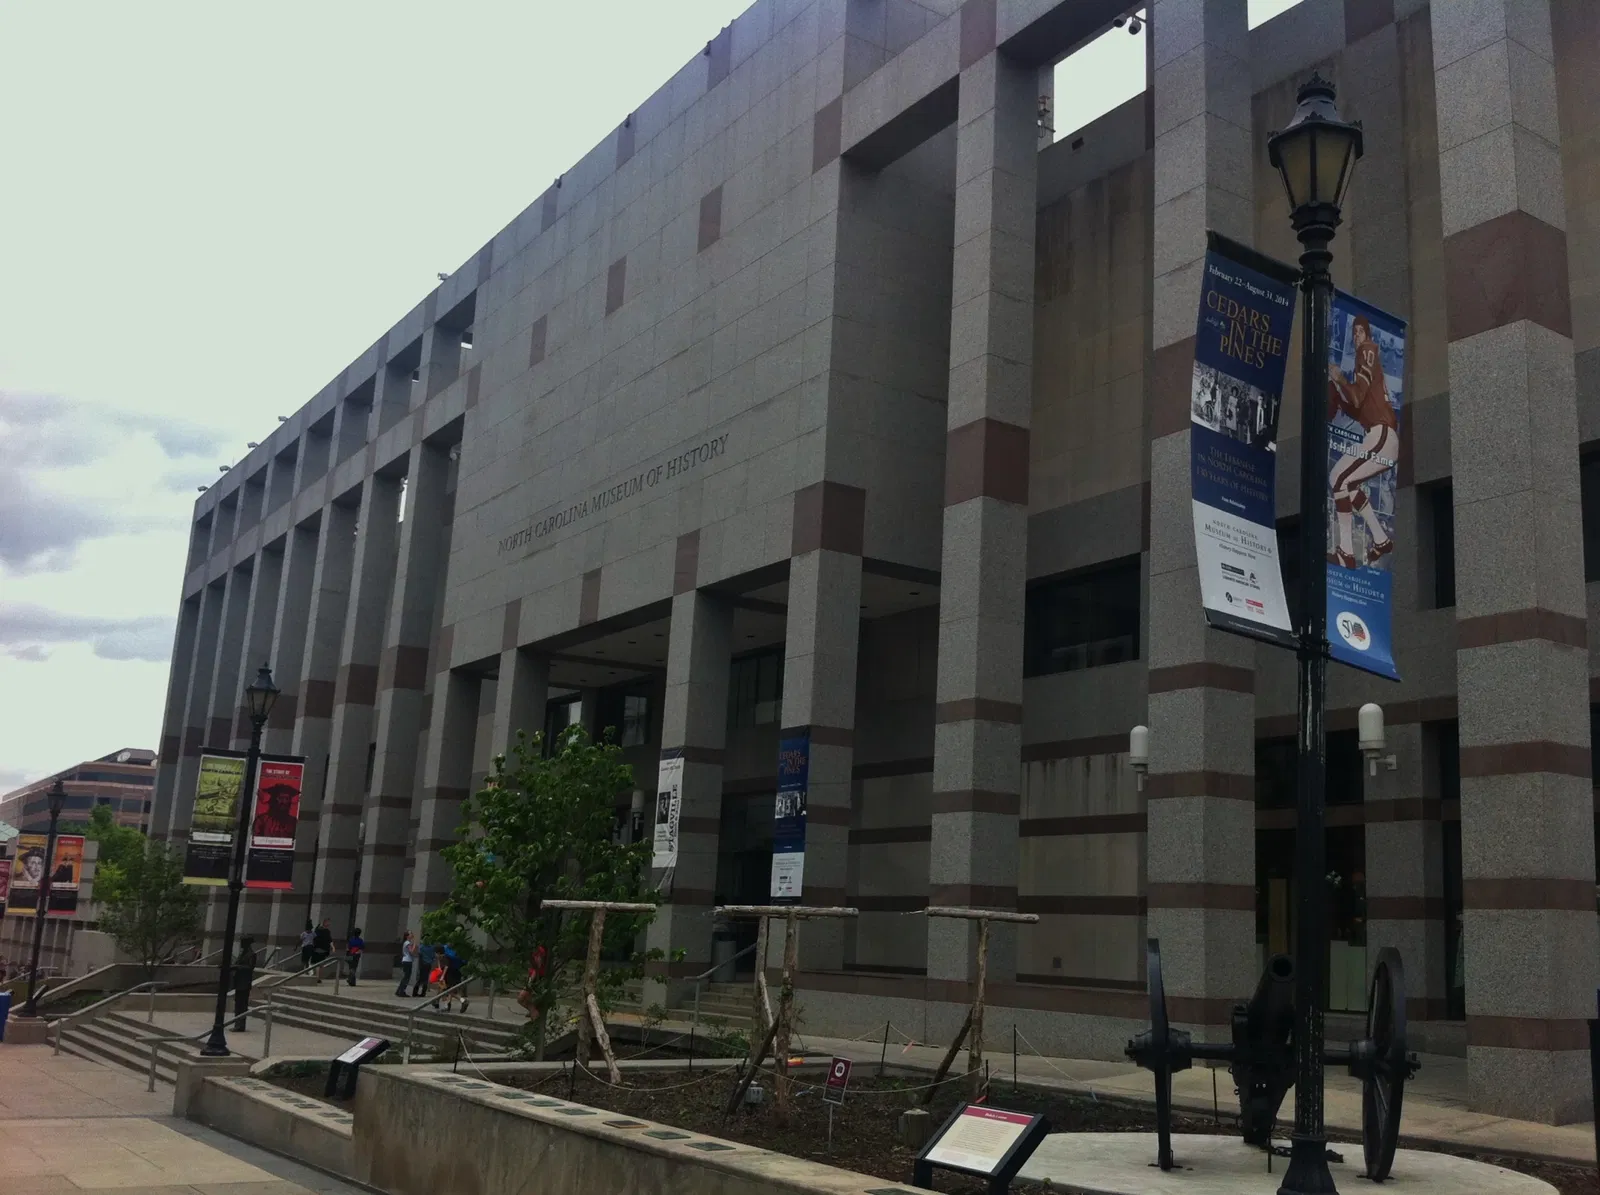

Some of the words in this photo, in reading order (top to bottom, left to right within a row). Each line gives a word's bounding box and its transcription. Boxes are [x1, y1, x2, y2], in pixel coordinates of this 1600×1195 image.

[1209, 264, 1233, 285] February
[1275, 295, 1289, 307] 2014
[1207, 290, 1270, 333] CEDARS
[1220, 334, 1265, 369] PINES
[1251, 328, 1283, 356] THE
[1362, 350, 1375, 367] 10
[1334, 427, 1360, 442] CAROLINA
[1208, 456, 1232, 473] NORTH
[1340, 441, 1357, 456] Hall
[1360, 449, 1369, 460] of
[1370, 452, 1394, 467] Fame
[498, 526, 532, 556] NORTH
[535, 500, 587, 538] CAROLINA
[591, 474, 644, 513] MUSEUM
[646, 465, 663, 487] OF
[666, 433, 729, 480] HISTORY
[1204, 523, 1231, 540] MUSEUM
[1241, 536, 1268, 552] HISTORY
[1213, 519, 1231, 530] NORTH
[1232, 526, 1258, 540] CAROLINA
[1344, 573, 1371, 587] CAROLINA
[1352, 582, 1380, 598] HISTORY
